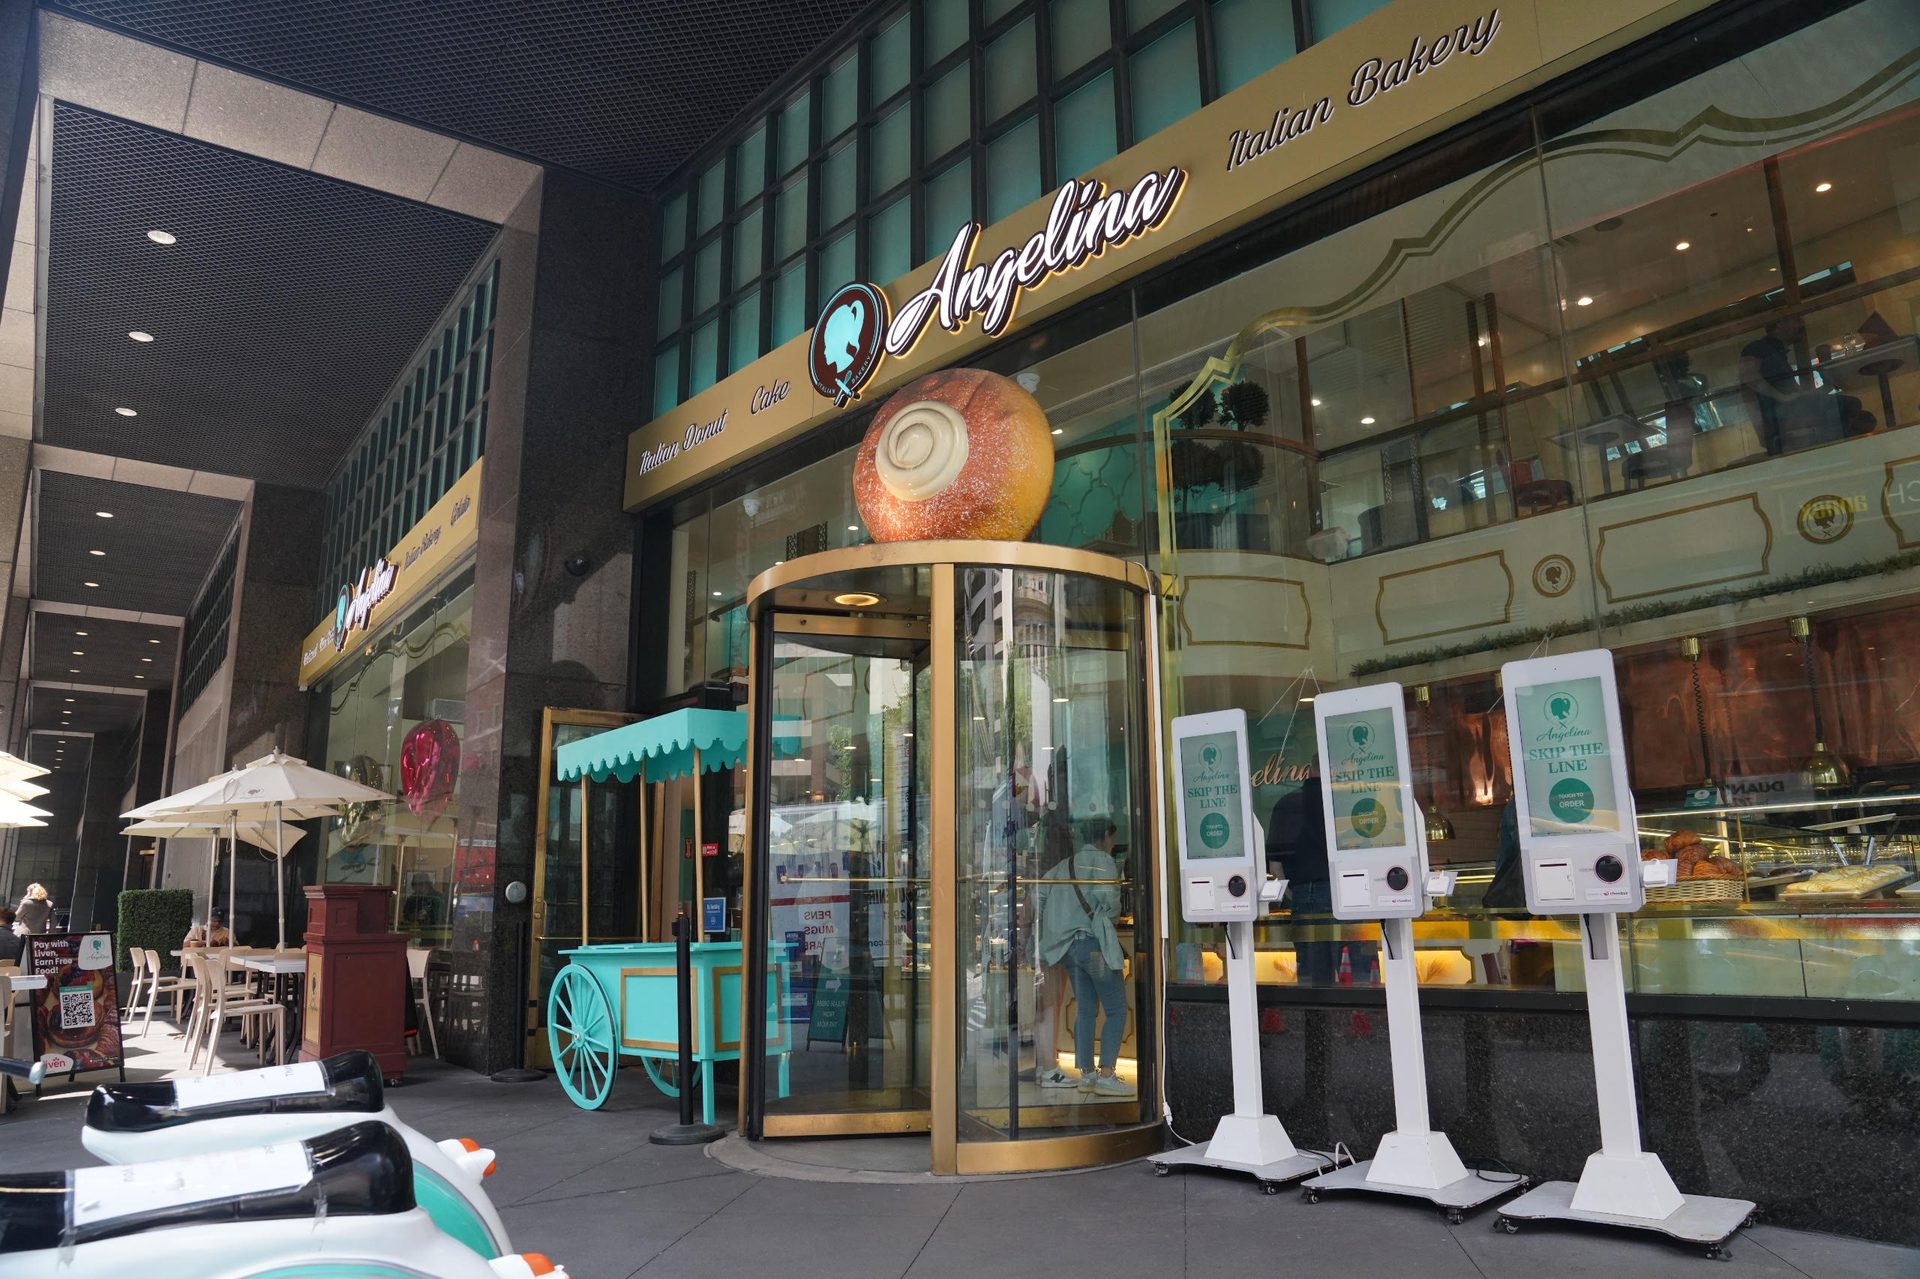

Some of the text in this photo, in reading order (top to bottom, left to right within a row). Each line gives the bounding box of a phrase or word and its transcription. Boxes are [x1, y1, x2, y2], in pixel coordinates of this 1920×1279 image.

[1226, 8, 1501, 172] Italian Bakery
[884, 166, 1185, 357] Angelina
[751, 379, 790, 416] Cake
[639, 409, 728, 476] Italian Donut
[1536, 727, 1592, 743] Angelina
[1341, 751, 1384, 766] Angelina
[1529, 742, 1604, 761] SKIP THE
[1250, 753, 1313, 788] elina
[1548, 759, 1588, 774] LINE
[1193, 771, 1230, 783] Angelina
[1335, 766, 1395, 783] SKIP THE
[1187, 784, 1238, 798] SKIP THE
[1351, 783, 1381, 794] LINE
[1200, 797, 1226, 809] LINE
[34, 940, 69, 949] Pay with
[34, 950, 58, 958] Liven,
[55, 957, 73, 965] Free
[35, 967, 59, 975] Food!
[45, 1058, 66, 1069] iven
